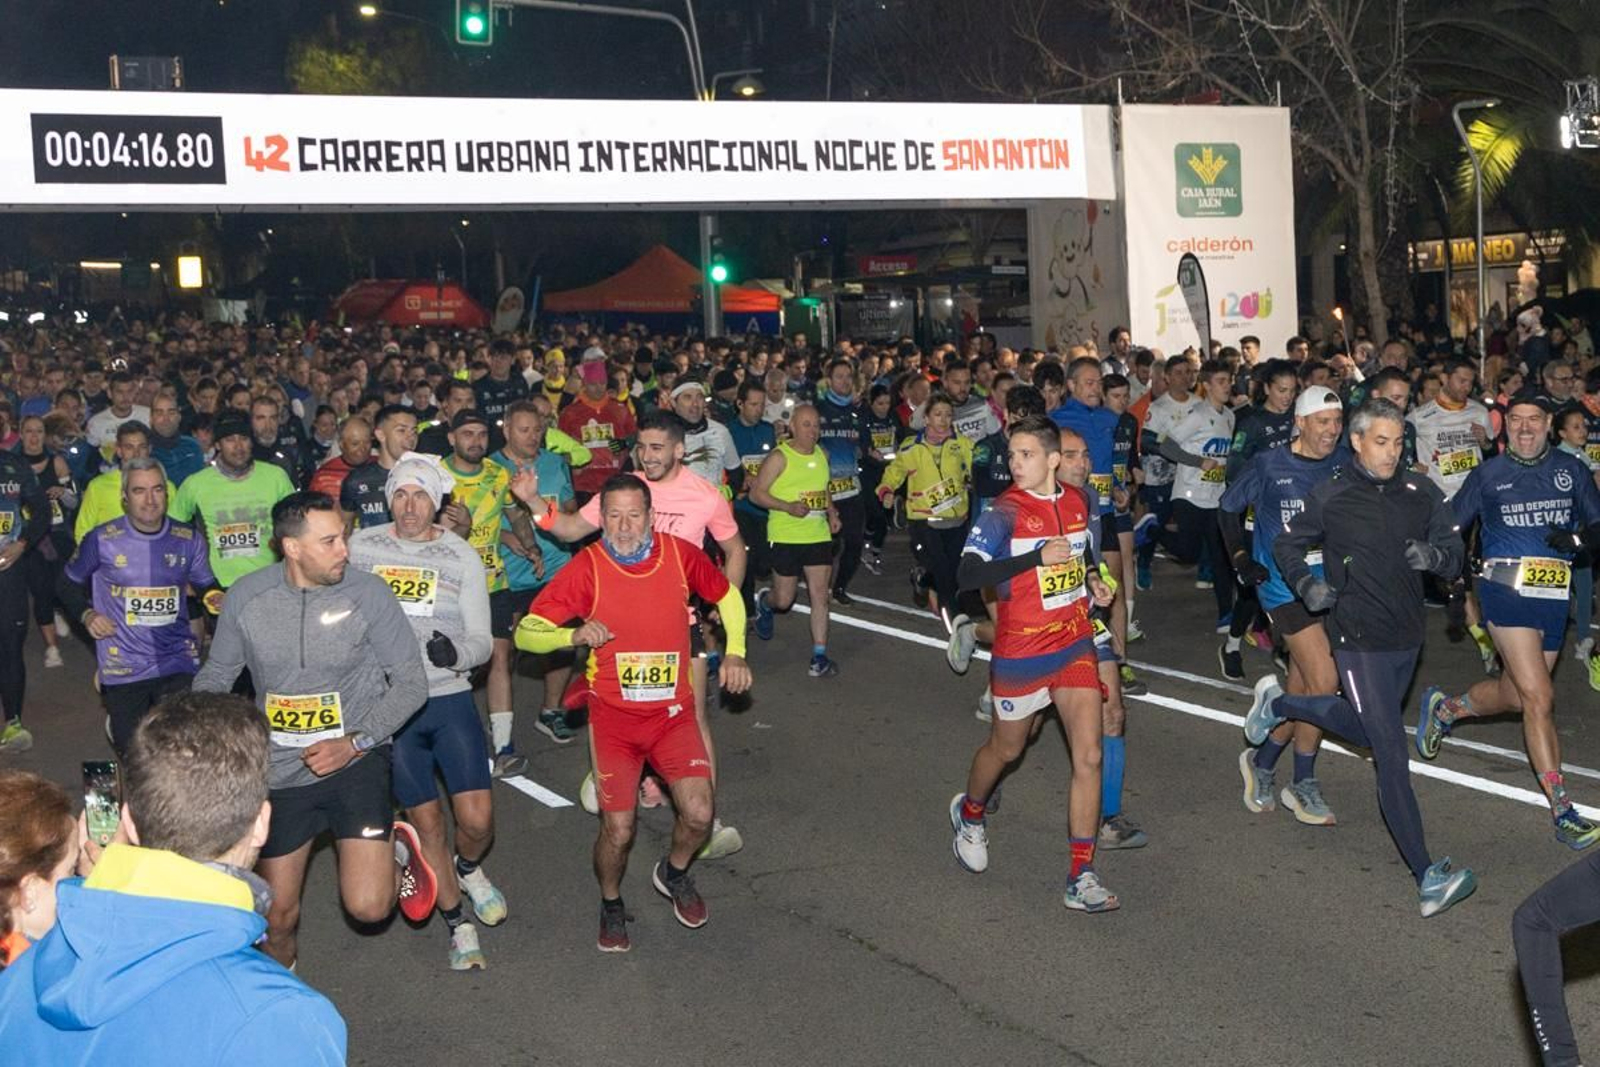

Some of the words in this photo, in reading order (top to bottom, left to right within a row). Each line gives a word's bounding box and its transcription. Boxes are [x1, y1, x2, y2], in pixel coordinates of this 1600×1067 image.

[45, 131, 213, 167] 00:04:16.80
[245, 135, 289, 171] 42
[298, 137, 446, 172] CARRERA
[456, 140, 569, 172] URBANA
[578, 141, 807, 172] INTERNACIONAL
[815, 141, 897, 171] NOCHE
[904, 140, 935, 170] DE
[942, 139, 989, 171] SAN
[1181, 187, 1204, 197] CAJA
[1206, 187, 1237, 197] RURAL
[1166, 236, 1253, 252] calderón
[1434, 238, 1516, 266] JMONEO
[1443, 456, 1474, 474] 3967
[360, 501, 385, 514] SAN
[1500, 503, 1525, 513] CLUB
[219, 532, 257, 546] 9095
[1045, 567, 1084, 592] 3750
[1527, 568, 1567, 584] 3233
[390, 579, 429, 597] 628
[130, 598, 176, 612] 9458
[622, 666, 672, 683] 4481
[272, 709, 335, 728] 4276
